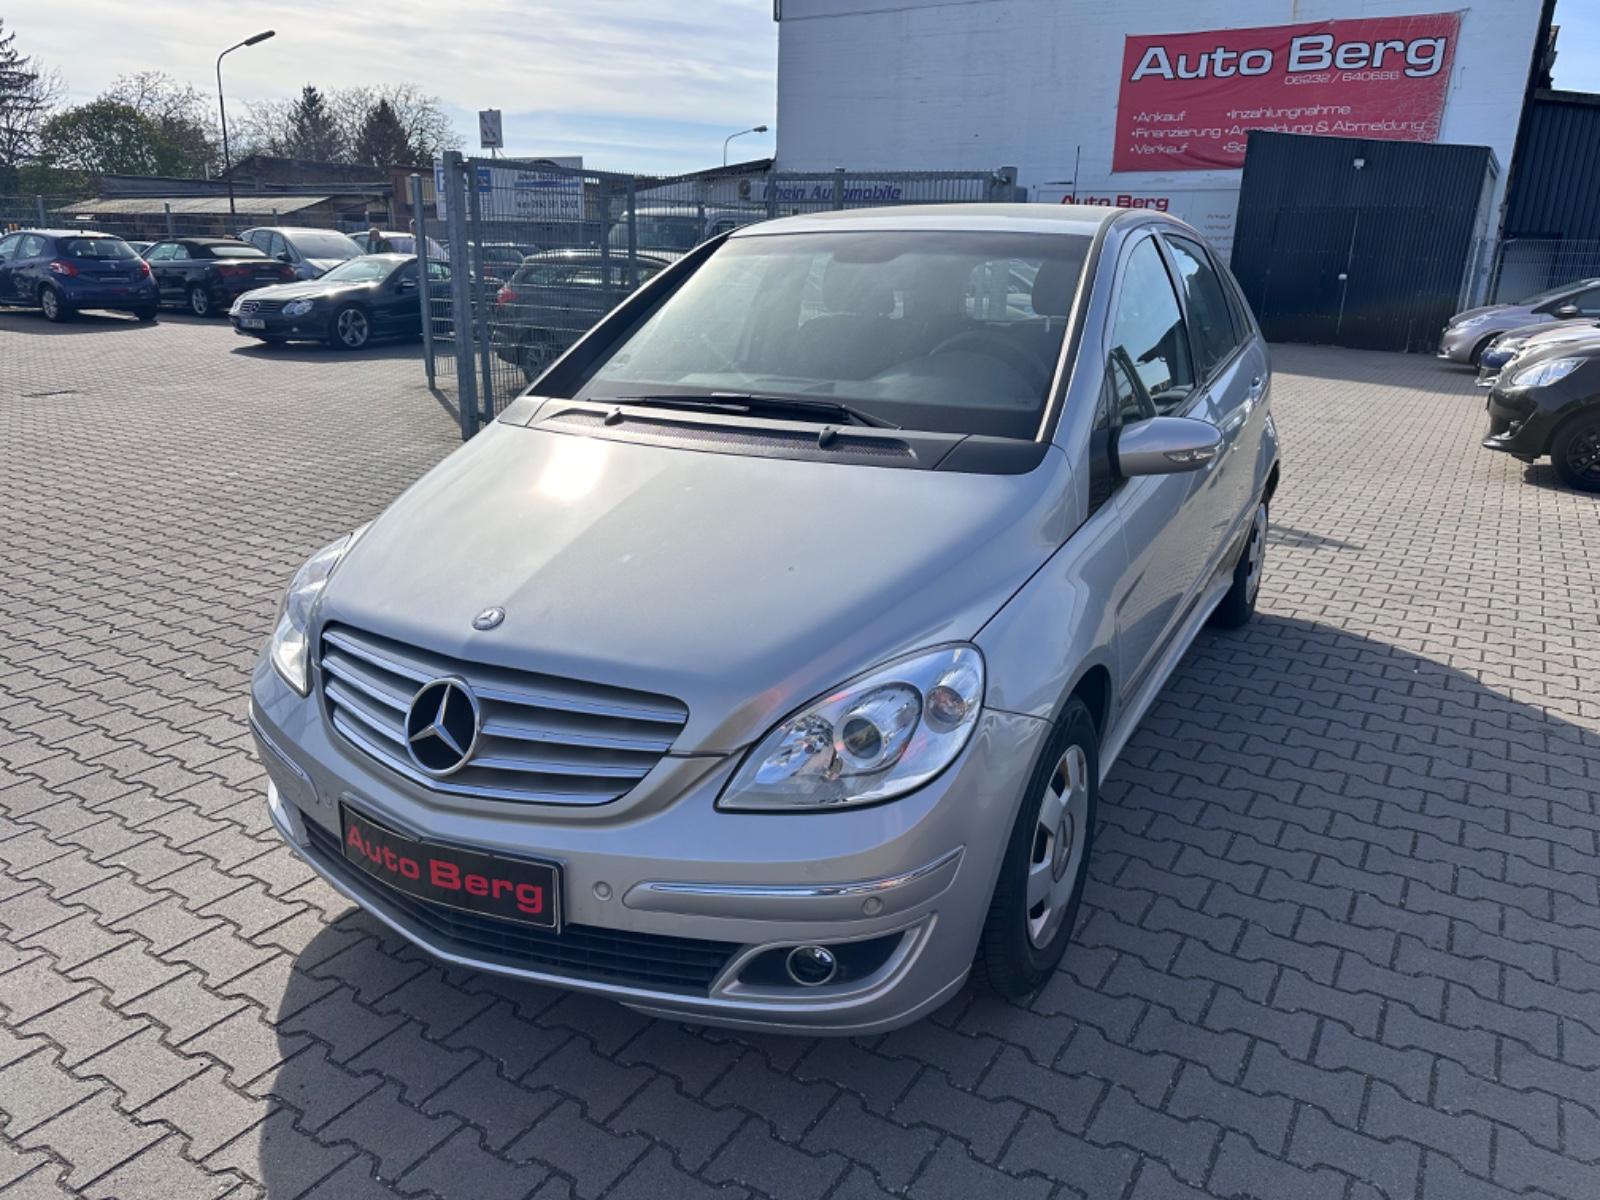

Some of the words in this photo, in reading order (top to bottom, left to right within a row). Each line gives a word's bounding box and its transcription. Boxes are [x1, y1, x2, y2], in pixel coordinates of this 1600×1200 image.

[1129, 45, 1273, 82] Auto
[1287, 33, 1447, 78] Berg
[1284, 73, 1331, 85] 06232
[1137, 110, 1186, 122] Ankauf
[1231, 104, 1351, 120] Inzahlungnahme
[1135, 127, 1222, 139] Finanzierung
[1315, 120, 1329, 133] &
[1331, 119, 1426, 133] Abmeldung
[1134, 142, 1190, 154] Verkauf
[1061, 194, 1111, 207] Auto
[1116, 194, 1170, 212] Berg
[346, 823, 421, 880] Auto
[429, 858, 544, 914] Berg
